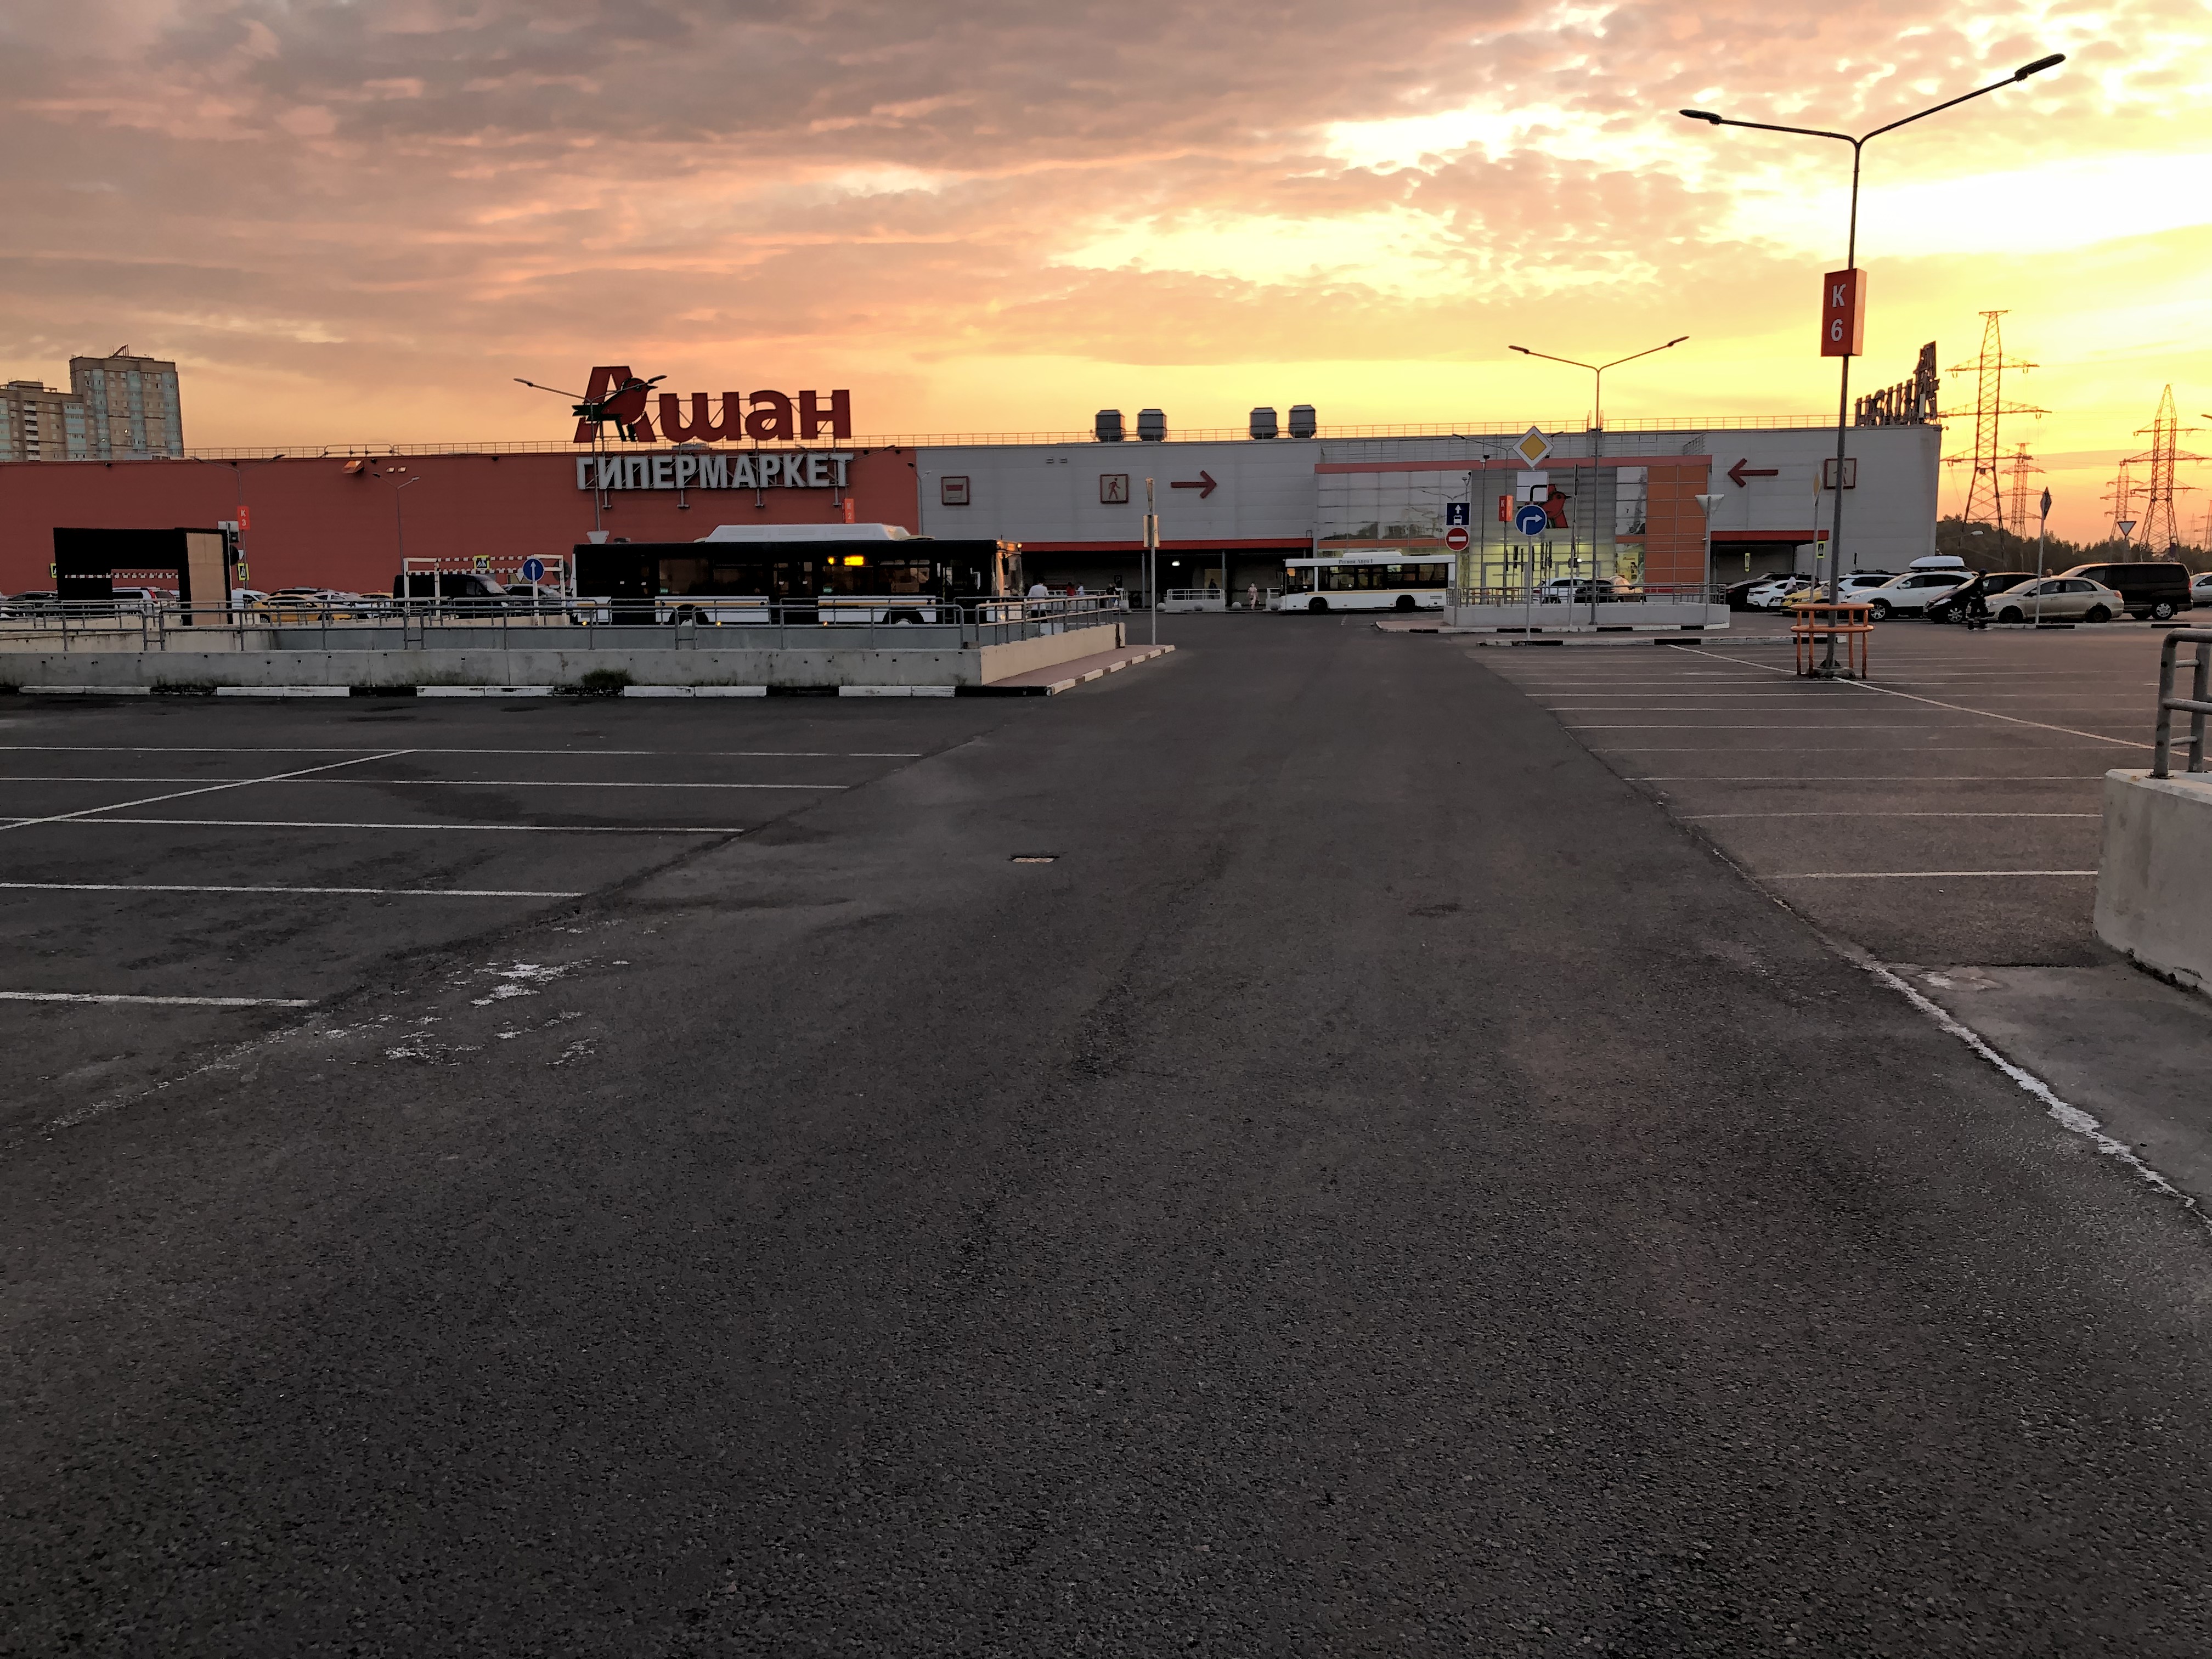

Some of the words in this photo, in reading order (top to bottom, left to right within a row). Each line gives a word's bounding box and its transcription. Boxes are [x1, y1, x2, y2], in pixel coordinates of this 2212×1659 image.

[1832, 284, 1846, 308] К
[1831, 318, 1843, 341] 6
[573, 365, 851, 442] Ашан
[576, 453, 854, 490] ГИПЕРМАРКЕТ
[240, 509, 246, 517] К
[241, 518, 247, 527] 3
[1501, 510, 1504, 518] 1
